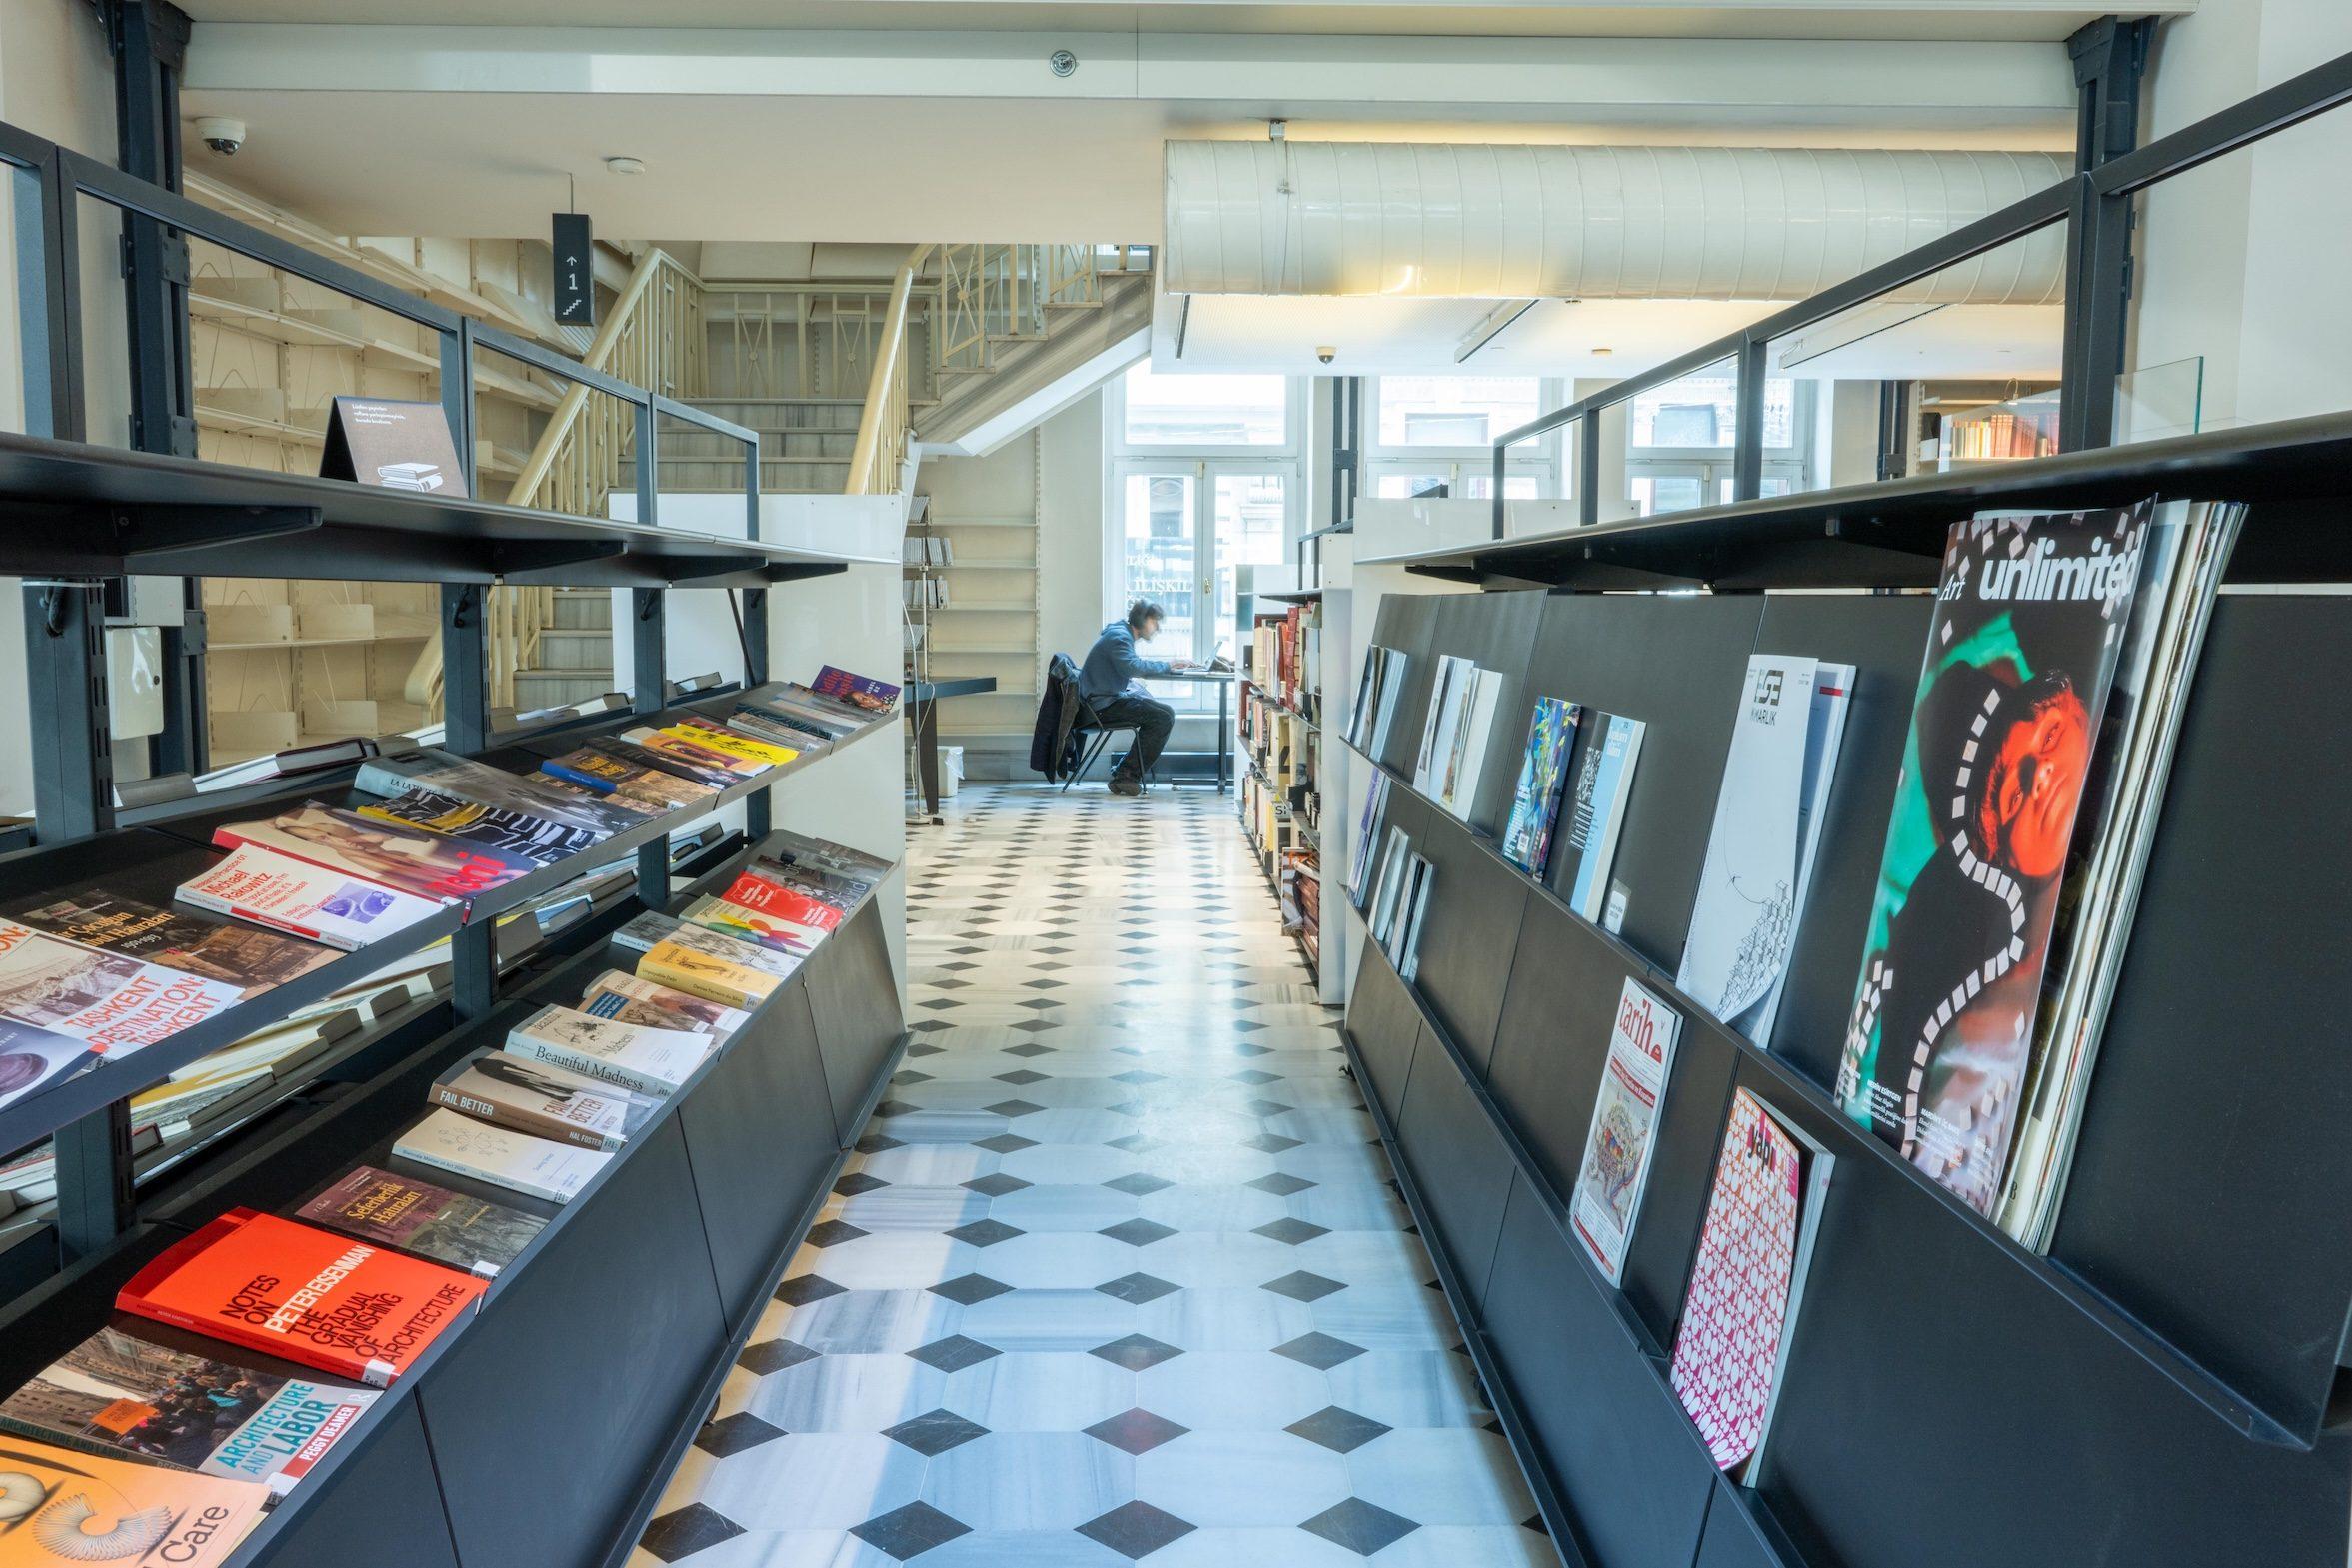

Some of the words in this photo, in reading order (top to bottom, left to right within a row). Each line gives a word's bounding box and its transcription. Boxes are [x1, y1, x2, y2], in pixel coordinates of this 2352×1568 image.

[569, 274, 578, 290] 1
[1939, 575, 1965, 601] Art
[1979, 522, 2147, 601] unlimited
[201, 869, 250, 895] Michael
[220, 872, 273, 900] Rakowitz
[63, 974, 163, 1029] TASHKENT
[86, 975, 208, 1045] DESTINATION:
[127, 990, 221, 1046] TASHKENT
[1619, 993, 1654, 1055] tarih
[535, 1046, 589, 1073] Beautiful
[591, 1063, 644, 1090] Madness
[439, 1090, 457, 1106] FAIL
[460, 1096, 493, 1117] BETTER
[567, 1098, 604, 1124] BETTER
[347, 1181, 405, 1220] Seferberlik
[219, 1274, 280, 1319] NOTES
[244, 1301, 277, 1325] ON
[263, 1286, 322, 1334] PETER
[308, 1245, 376, 1294] EISENMAN
[287, 1309, 329, 1336] THE
[310, 1291, 379, 1345] GRADUAL
[332, 1293, 403, 1349] VANISHING
[378, 1283, 466, 1364] ARCHITECTURE
[354, 1338, 384, 1358] OF
[215, 1383, 314, 1468] ARCHITECTURE
[241, 1451, 274, 1475] AND
[260, 1400, 338, 1455] LABOR
[300, 1436, 328, 1461] PEGGY
[325, 1406, 357, 1437] DEAMER
[160, 1506, 229, 1563] Care
